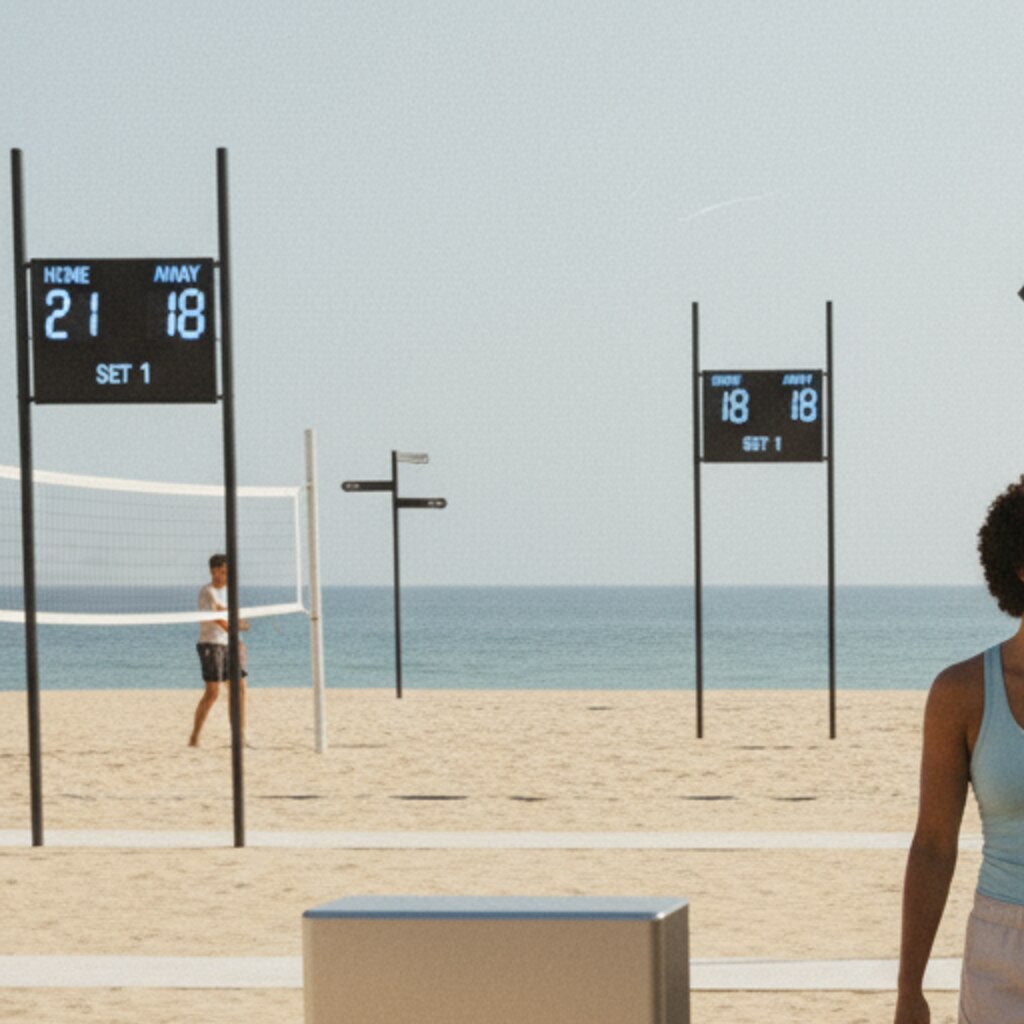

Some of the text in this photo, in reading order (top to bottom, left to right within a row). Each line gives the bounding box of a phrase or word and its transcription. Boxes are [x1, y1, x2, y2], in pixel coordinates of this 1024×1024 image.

[45, 288, 206, 340] 21 18
[95, 361, 151, 385] SET 1
[721, 387, 818, 425] 18 18
